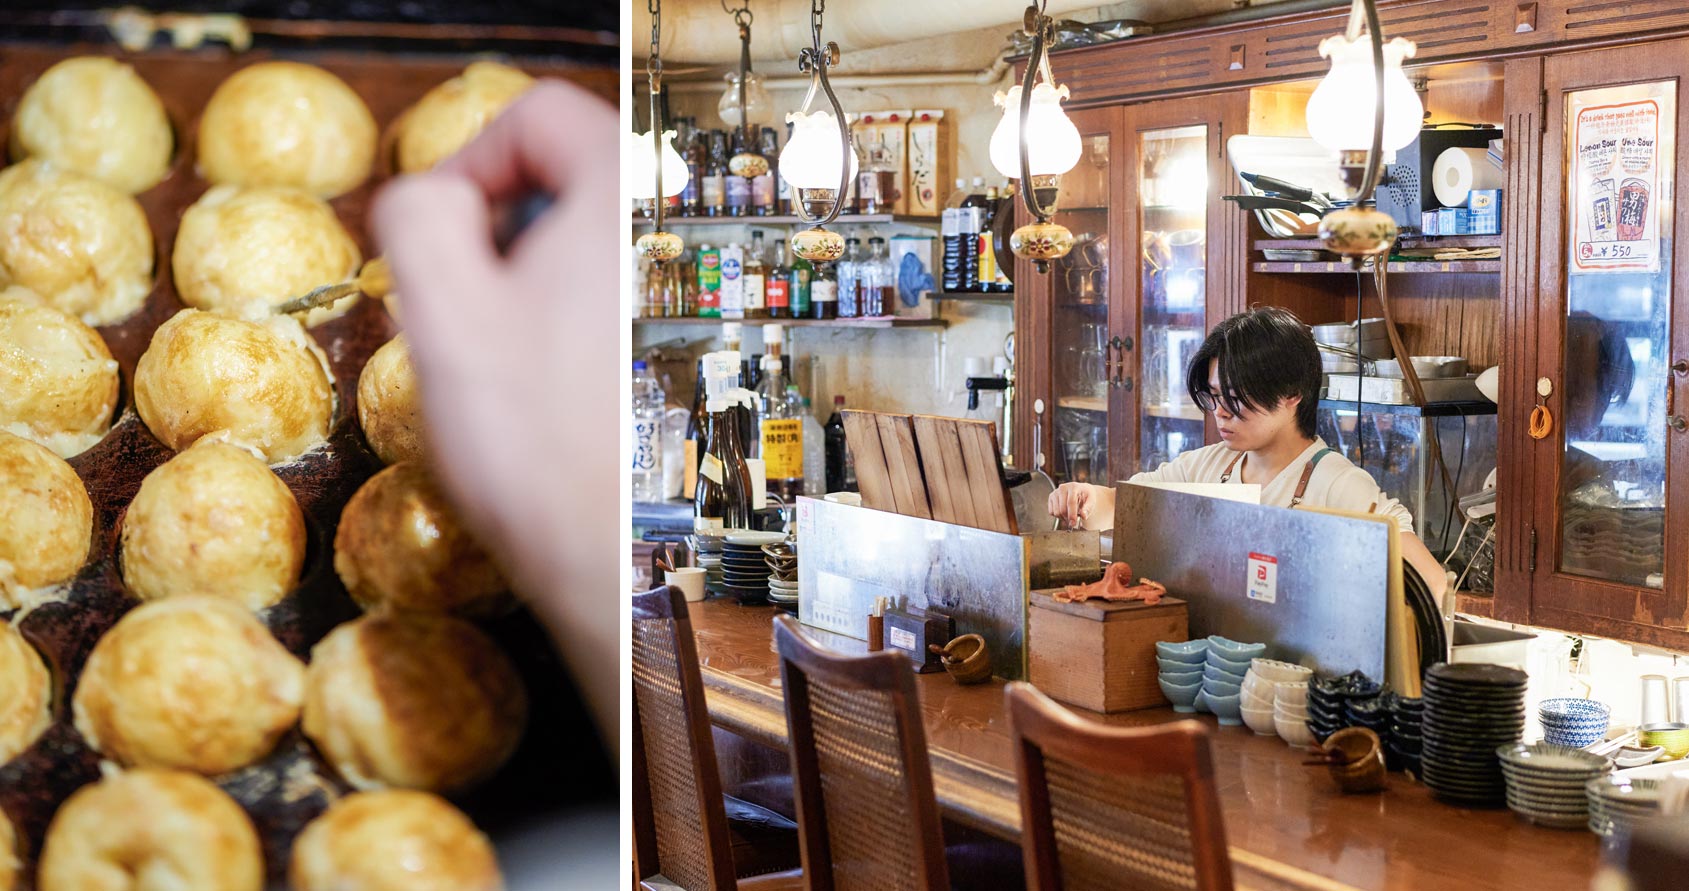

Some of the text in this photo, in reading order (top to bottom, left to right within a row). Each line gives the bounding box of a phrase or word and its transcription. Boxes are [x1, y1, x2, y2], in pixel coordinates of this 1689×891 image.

[1580, 140, 1617, 153] Lemon Sour
[1637, 138, 1654, 147] Sour
[1601, 247, 1608, 257] ¥
[1612, 244, 1631, 257] 550
